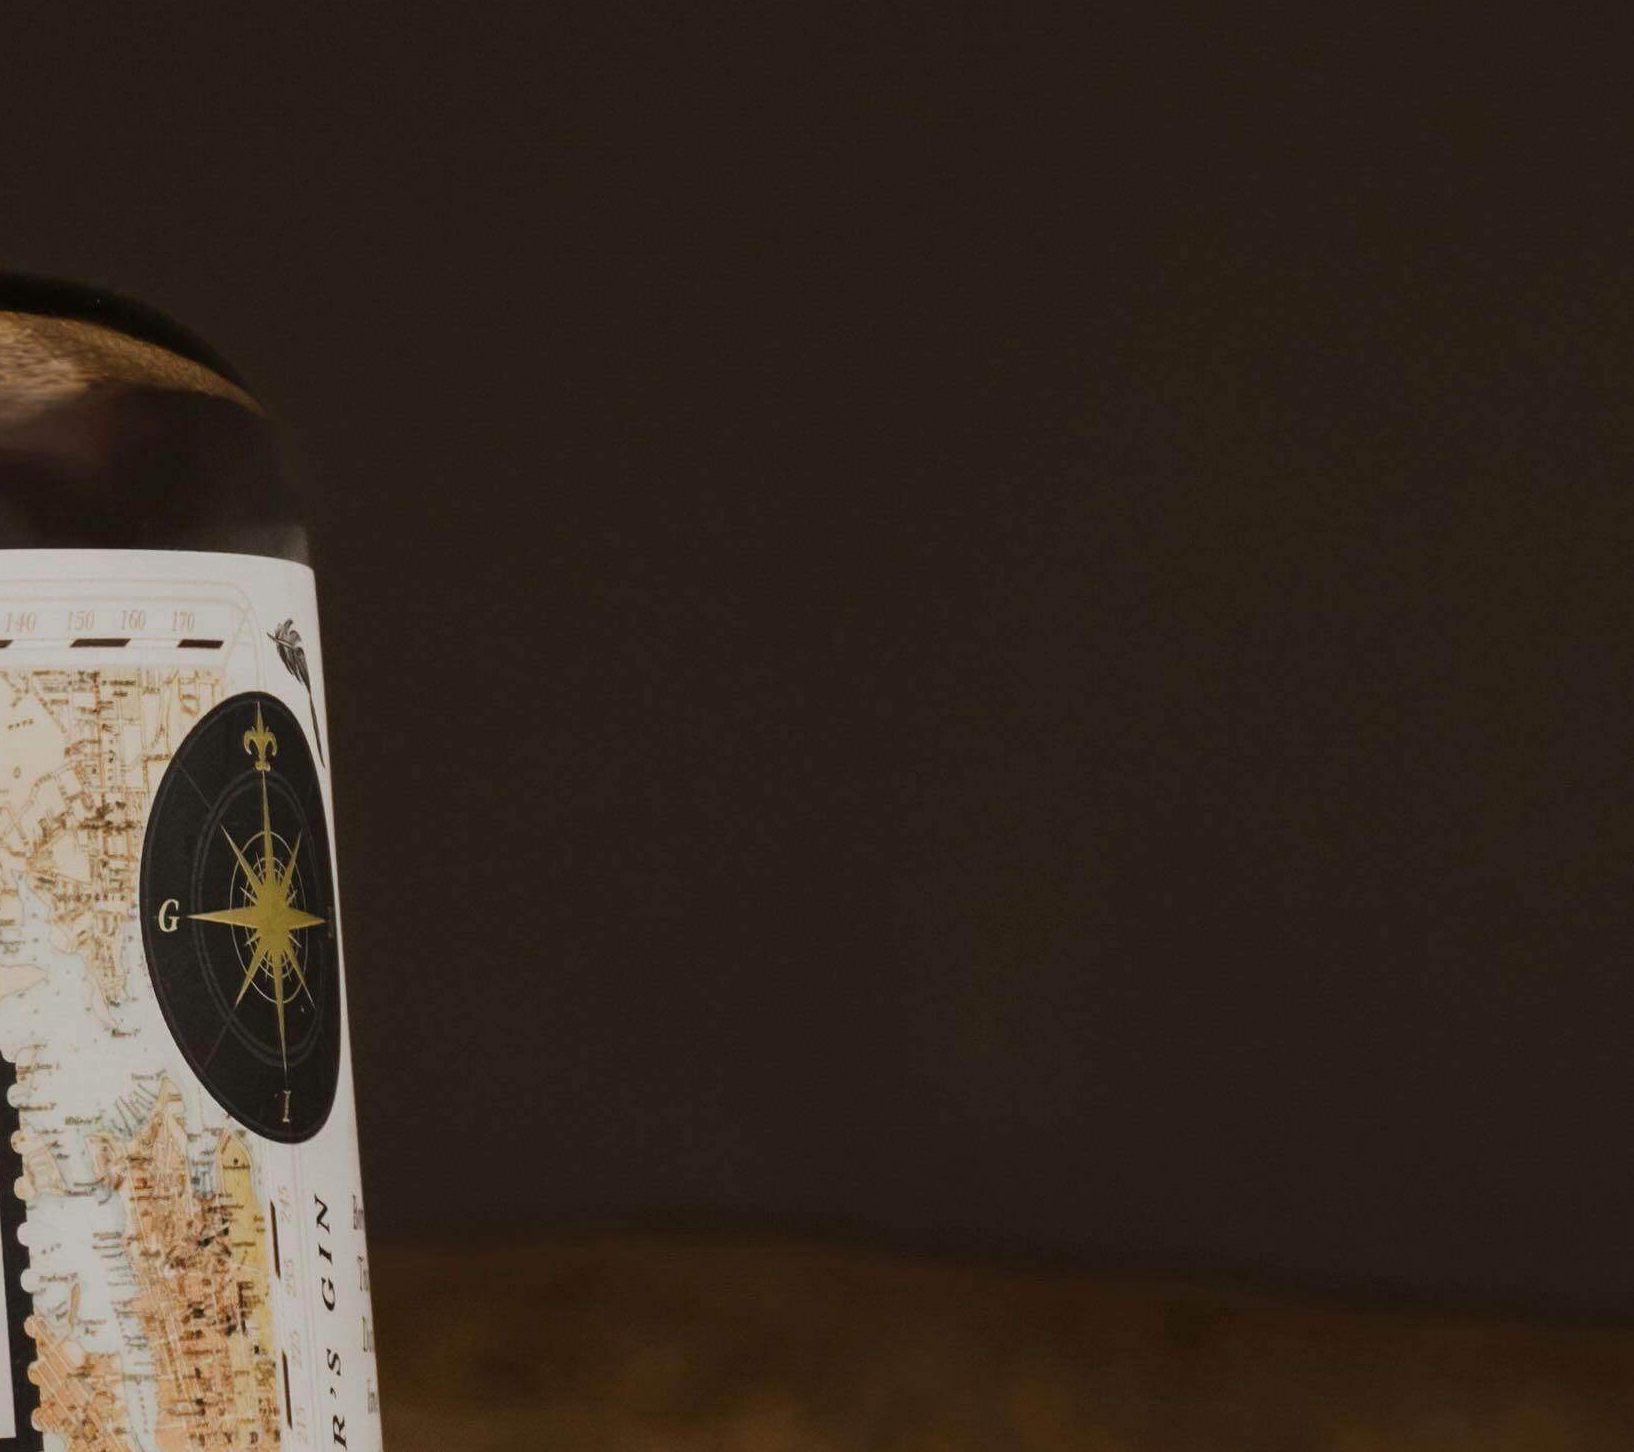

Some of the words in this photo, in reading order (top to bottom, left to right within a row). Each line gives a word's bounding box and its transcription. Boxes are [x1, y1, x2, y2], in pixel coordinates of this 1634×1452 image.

[4, 611, 37, 633] 140
[66, 610, 95, 631] 150
[119, 609, 147, 630] 160
[170, 610, 196, 632] 170
[158, 898, 181, 933] G
[314, 1193, 337, 1313] GIN
